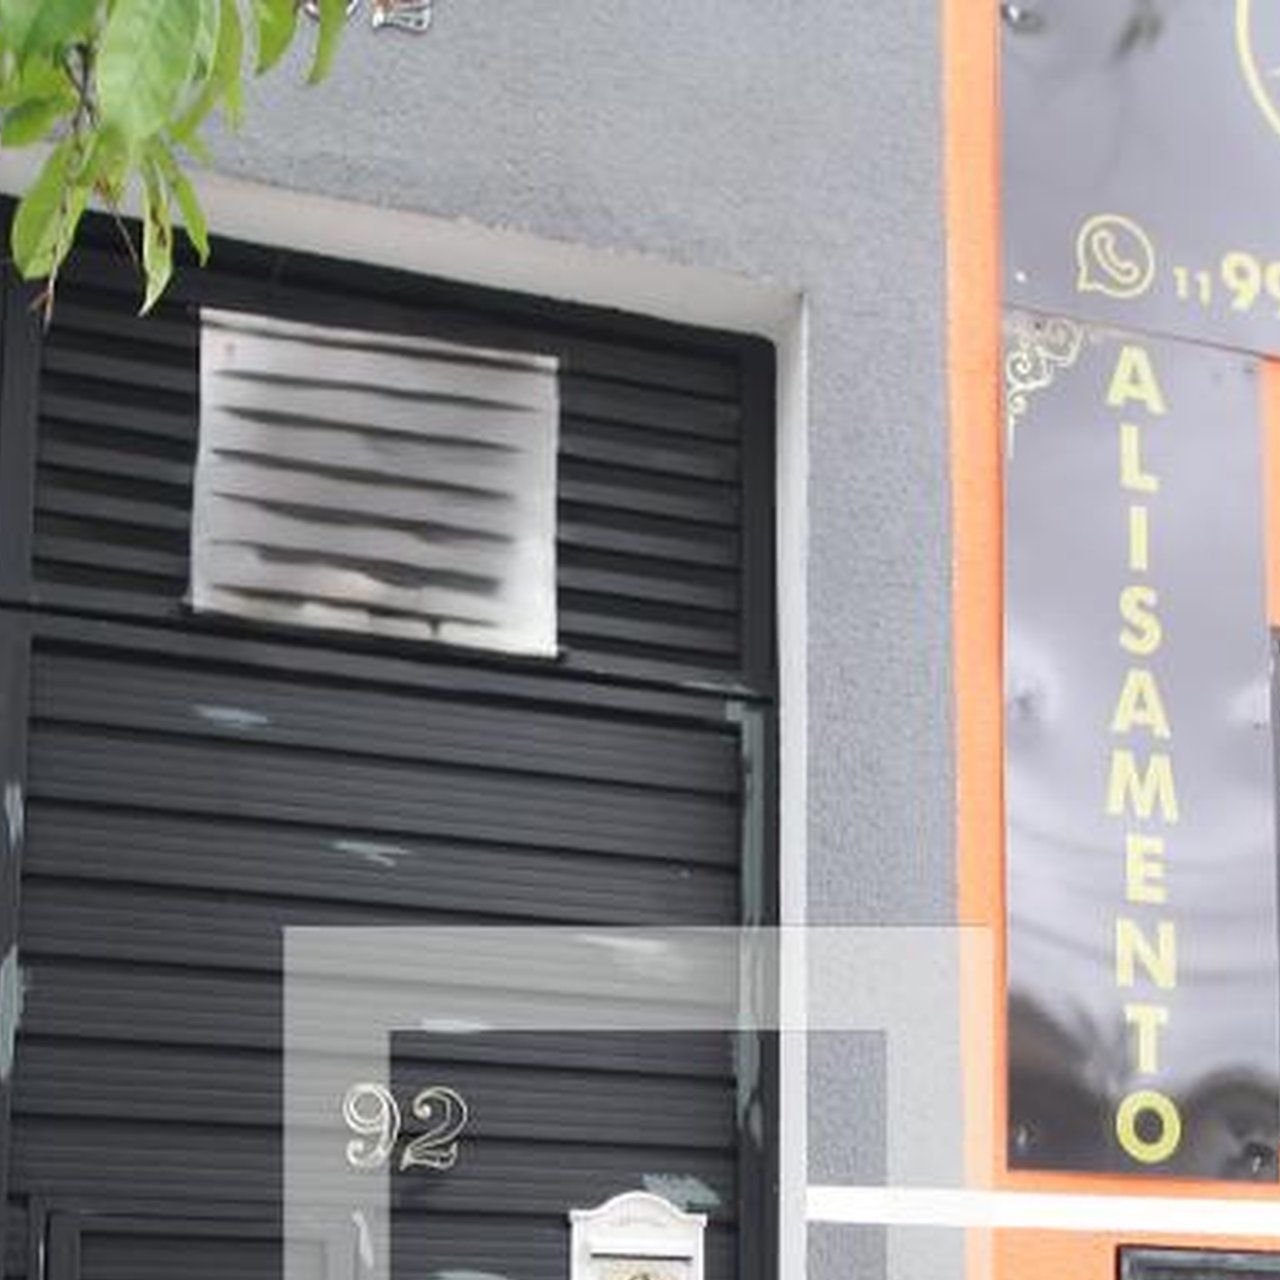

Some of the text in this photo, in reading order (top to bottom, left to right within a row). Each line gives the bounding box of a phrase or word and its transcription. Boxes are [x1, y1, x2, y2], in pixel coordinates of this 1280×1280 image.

[1172, 265, 1213, 305] 11
[1104, 345, 1182, 1164] ALISAMENTO
[341, 1080, 469, 1171] 92
